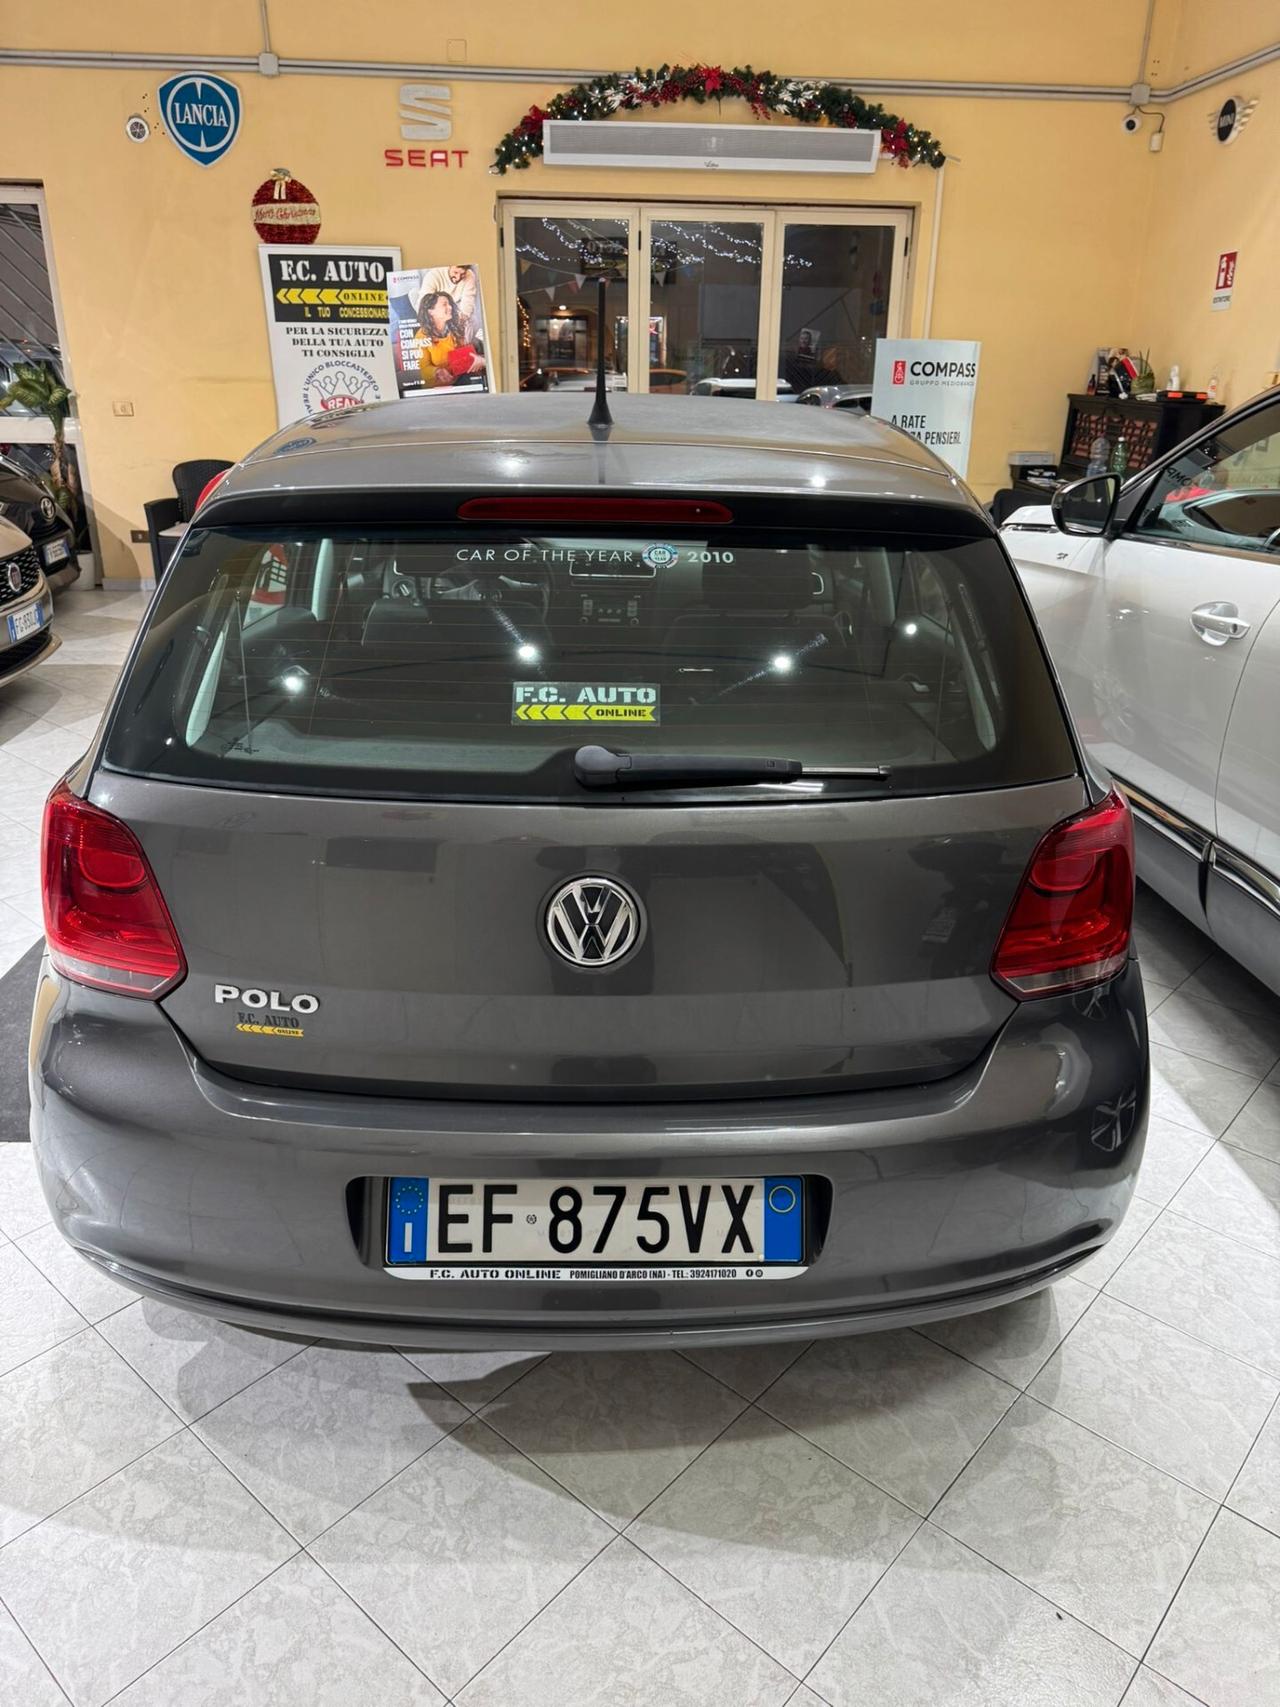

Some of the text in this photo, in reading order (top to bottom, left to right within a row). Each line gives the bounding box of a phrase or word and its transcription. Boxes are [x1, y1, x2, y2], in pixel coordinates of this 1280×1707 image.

[174, 102, 229, 128] LANCIA
[384, 148, 469, 168] SEAT
[280, 260, 386, 282] F.C. AUTO
[343, 292, 385, 301] ONLINE
[317, 307, 331, 318] TUO
[339, 307, 389, 319] CONCESSIONARI
[286, 327, 388, 336] PER LA SICUREZZA
[399, 328, 414, 339] CON
[292, 338, 326, 347] DELLA
[329, 339, 352, 347] TUA
[400, 337, 432, 350] COMPASS
[302, 349, 375, 358] TI CONSIGLIA
[401, 350, 409, 360] SI
[403, 361, 420, 371] FARE
[910, 361, 976, 378] COMPASS
[891, 415, 926, 429] A RATE
[456, 549, 633, 563] CAR OF THE YEAR
[687, 551, 734, 563] 2010
[515, 686, 656, 703] F.C. AUTO
[595, 707, 647, 718] ONLINE
[214, 983, 320, 1014] POLO
[237, 1012, 299, 1027] F.C. AUTO
[438, 1183, 755, 1254] EF 875VX
[404, 1222, 413, 1253] I
[429, 1269, 455, 1279] F.C.
[460, 1269, 500, 1279] AUTO
[504, 1269, 561, 1279] ONLINE
[569, 1269, 618, 1280] POMIGLIANO
[619, 1270, 648, 1279] D'ARCO
[650, 1269, 667, 1280] (NA)
